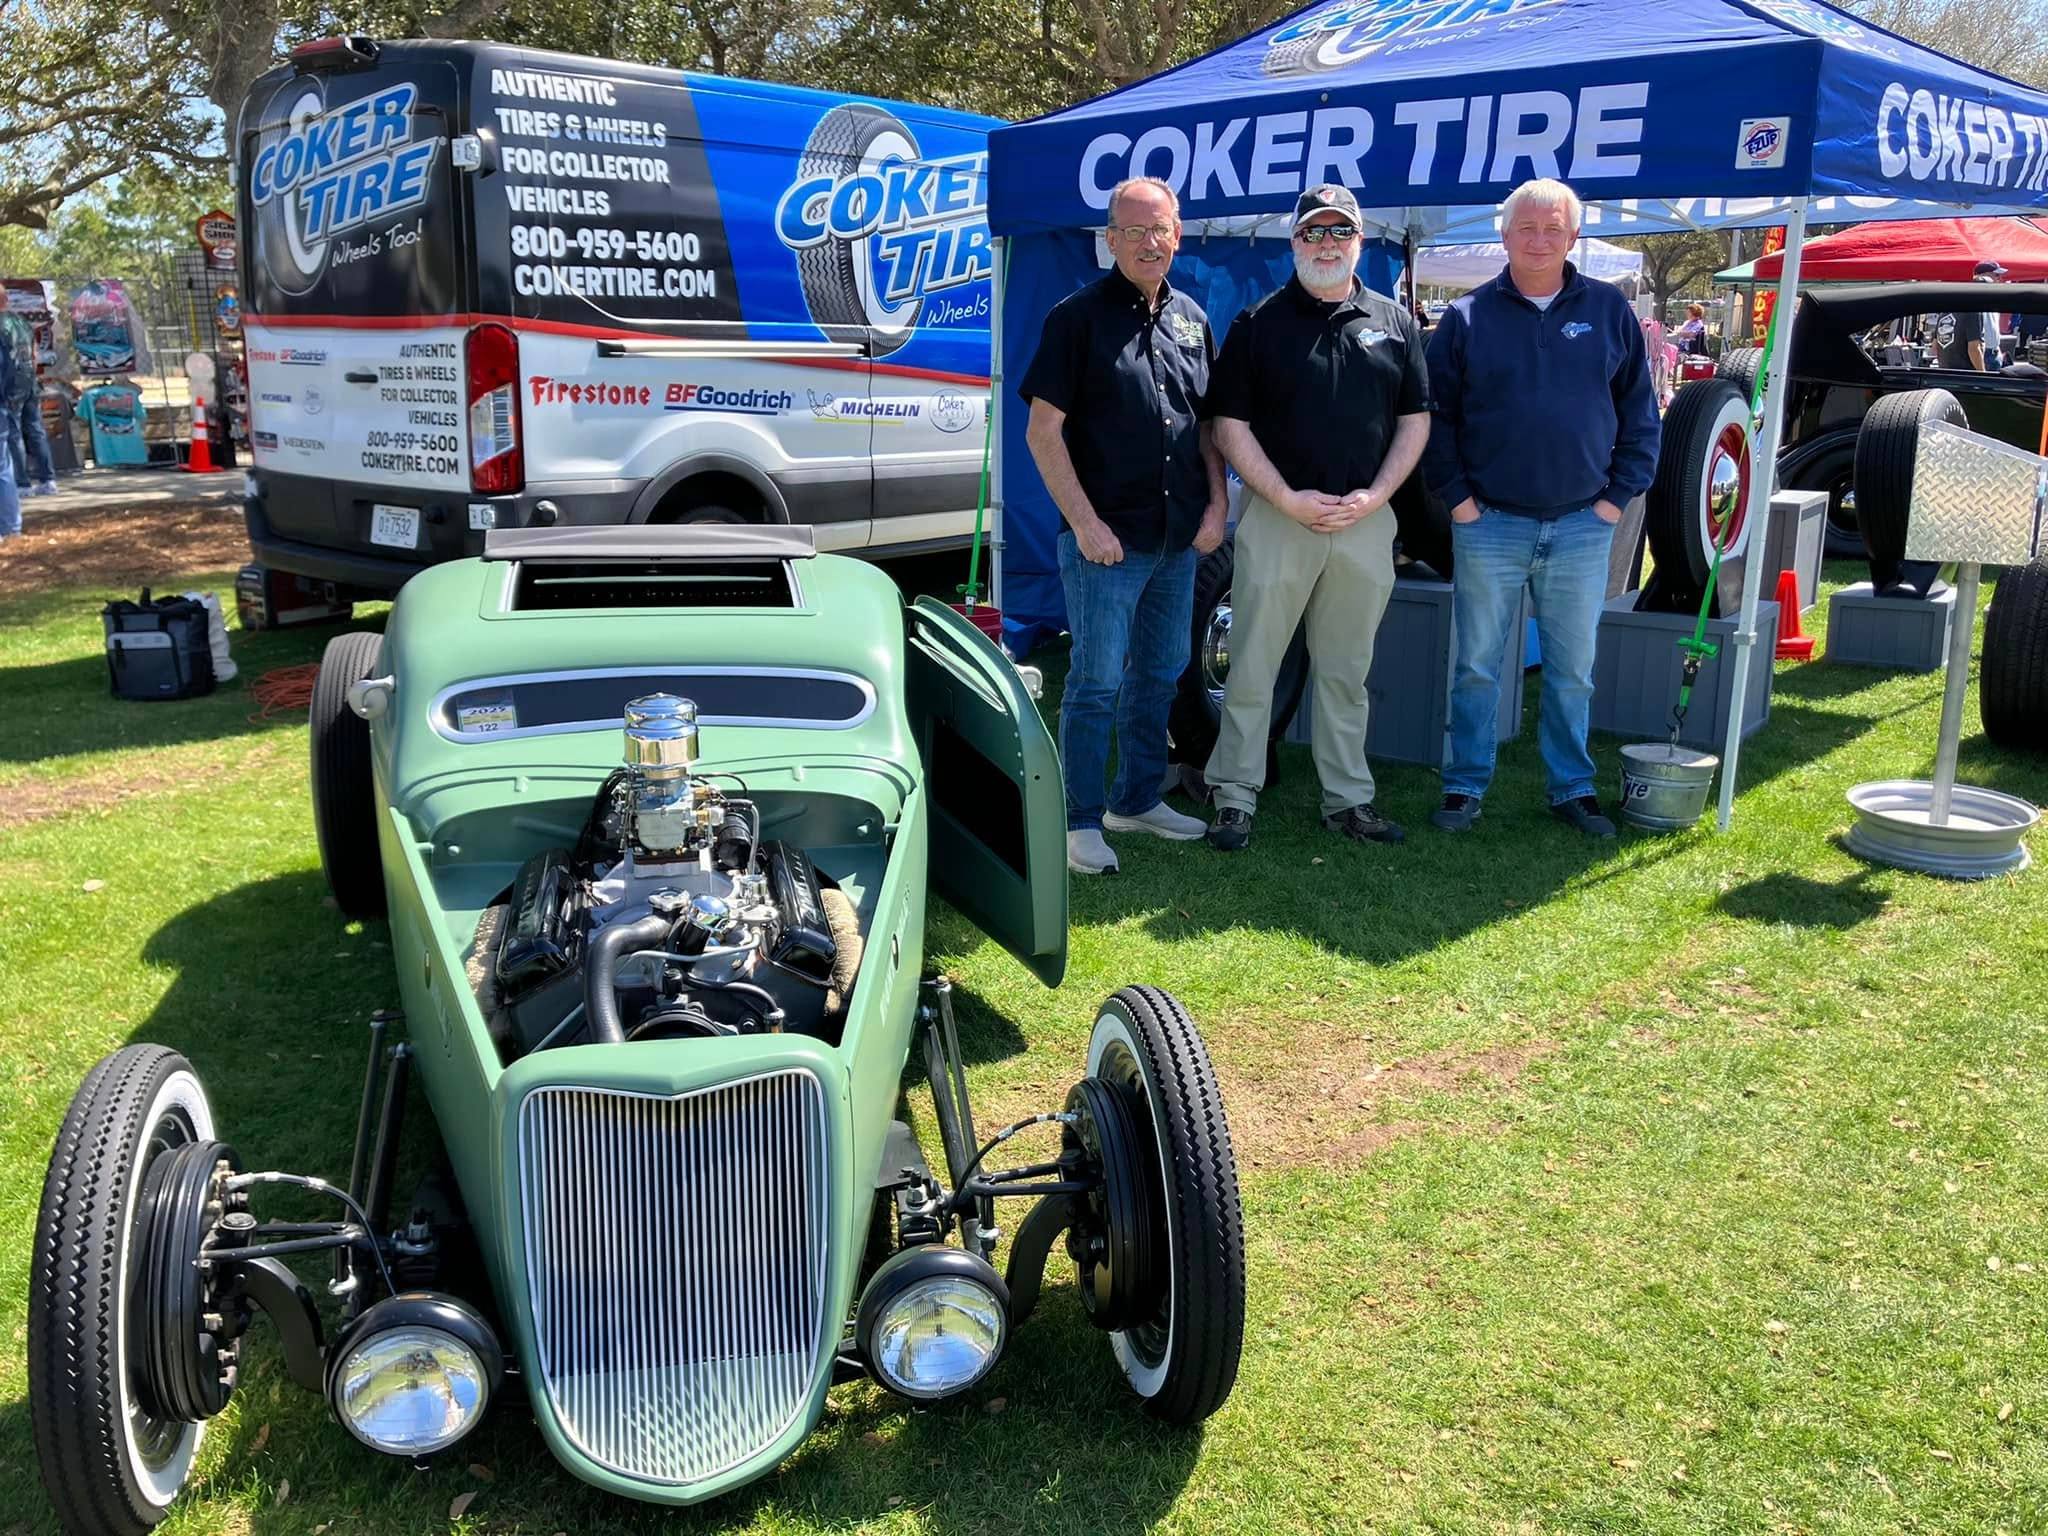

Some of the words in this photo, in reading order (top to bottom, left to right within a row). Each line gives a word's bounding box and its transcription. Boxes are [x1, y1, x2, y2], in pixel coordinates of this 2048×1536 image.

[491, 69, 616, 106] AUTHENTIC
[252, 82, 417, 206] COKER
[494, 107, 561, 139] TIRES
[565, 113, 582, 140] &
[585, 115, 667, 148] WHEELS
[1877, 82, 2014, 187] COKER
[1078, 106, 1375, 210] COKER
[1394, 82, 1650, 185] TIRE
[501, 147, 548, 175] FOR
[550, 149, 671, 184] COLLECTOR
[300, 137, 439, 246] TIRE
[505, 185, 610, 216] VEHICLES
[332, 233, 382, 267] Wheels
[386, 218, 423, 249] Too!
[510, 225, 700, 262] 800-959-5600
[879, 219, 992, 300] TIR
[514, 264, 716, 298] COKERTIRE.COM
[926, 293, 989, 328] Wheels
[399, 344, 457, 358] AUTHENTIC
[379, 366, 404, 380] TIRES
[406, 366, 414, 380] &
[415, 366, 457, 381] WHEELS
[380, 387, 398, 402] FOR
[400, 388, 457, 404] COLLECTOR
[528, 375, 651, 407] Firestone
[664, 383, 792, 410] BFGoodrich
[408, 410, 457, 427] VEHICLES
[841, 401, 920, 417] MICHELIN
[367, 431, 458, 452] 800-959-5600
[362, 451, 459, 474] COKERTIRE.COM
[479, 723, 498, 733] 122
